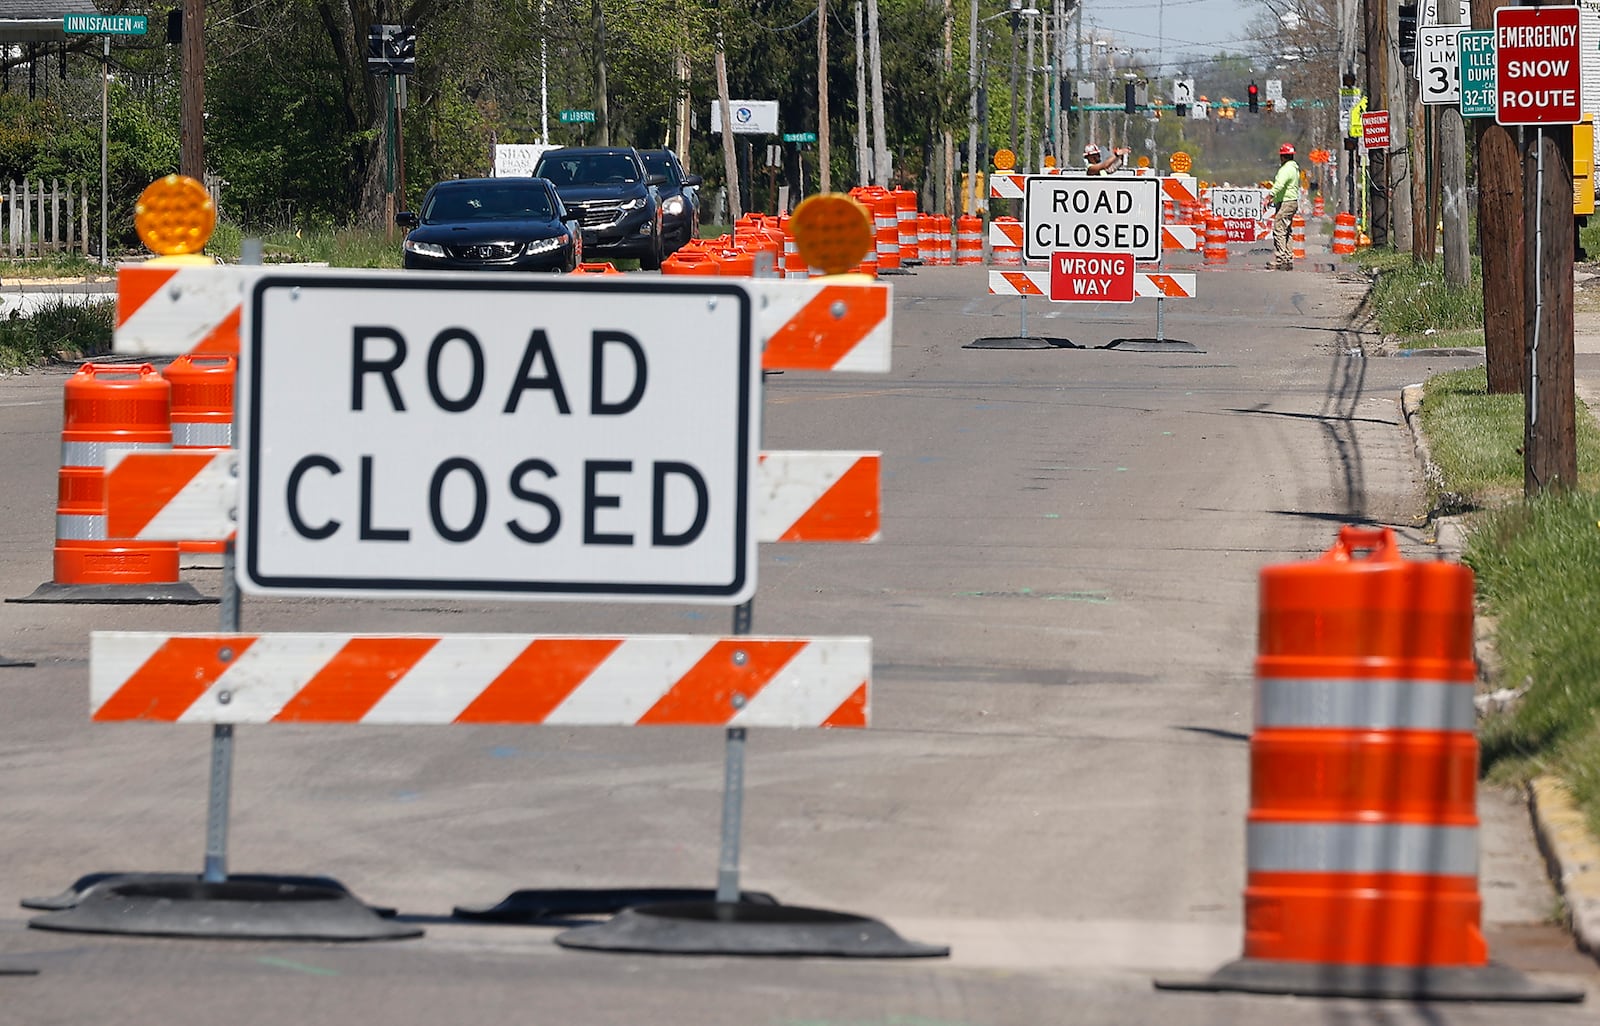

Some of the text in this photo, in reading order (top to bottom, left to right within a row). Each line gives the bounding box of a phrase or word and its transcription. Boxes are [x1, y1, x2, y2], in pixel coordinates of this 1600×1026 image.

[68, 16, 144, 31] INNISFALLEN AVE
[1425, 34, 1455, 47] SPE
[1462, 36, 1496, 52] REP
[1499, 25, 1577, 48] EMERGENCY
[1430, 51, 1456, 63] LIM
[1470, 53, 1496, 66] ILLE
[1468, 68, 1496, 81] DUMP
[1508, 60, 1570, 78] SNOW
[1428, 66, 1459, 94] 3
[1464, 89, 1496, 105] 32-TR
[1502, 89, 1576, 108] ROUTE
[562, 111, 595, 121] W LIBERTY
[1363, 116, 1388, 126] EMERGENCY
[1366, 127, 1387, 135] SNOW
[1365, 136, 1390, 144] ROUTE
[1052, 189, 1133, 214] ROAD
[1222, 194, 1252, 205] ROAD
[1215, 207, 1258, 217] CLOSED
[1035, 223, 1149, 248] CLOSED
[1227, 230, 1246, 239] WAY
[1060, 258, 1125, 275] WRONG
[1072, 279, 1112, 295] WAY
[350, 325, 649, 416] ROAD
[285, 453, 710, 547] CLOSED
